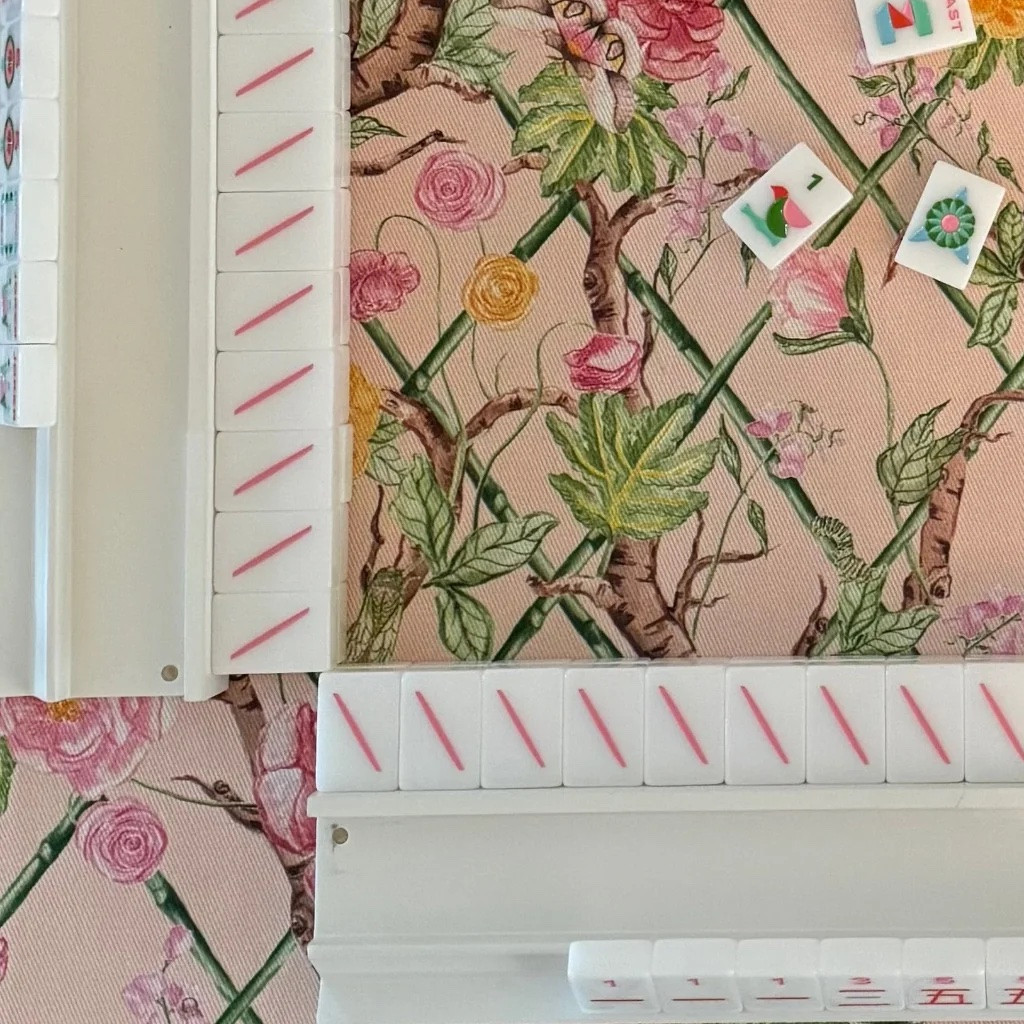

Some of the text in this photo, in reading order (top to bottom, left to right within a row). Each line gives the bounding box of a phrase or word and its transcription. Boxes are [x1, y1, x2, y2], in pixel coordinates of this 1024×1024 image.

[806, 173, 824, 191] 1
[838, 989, 892, 1007] 三
[919, 988, 973, 1005] 五
